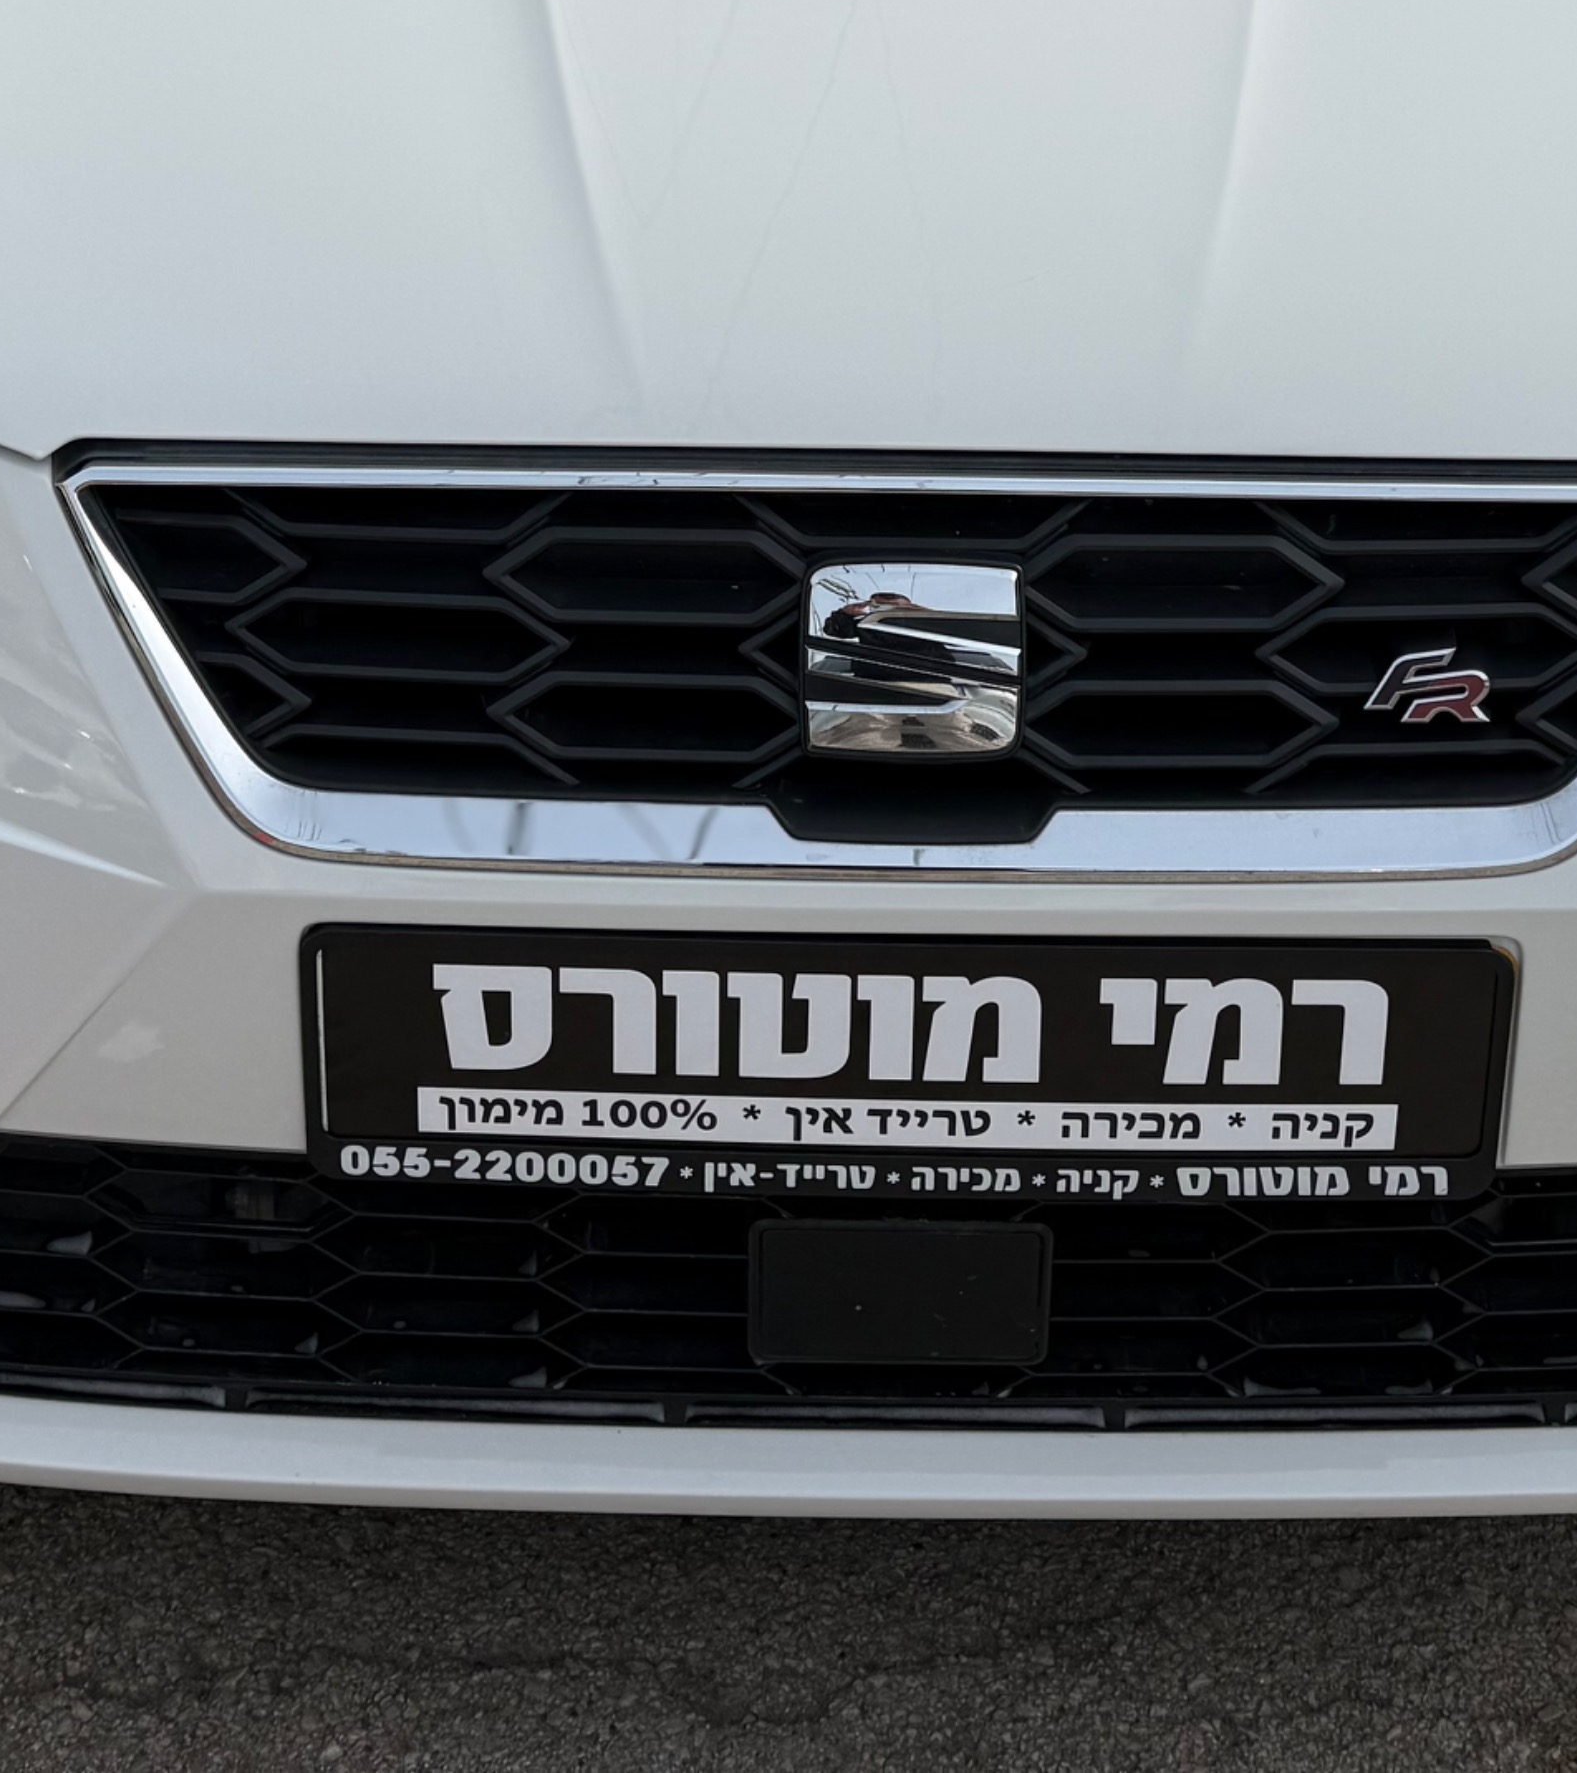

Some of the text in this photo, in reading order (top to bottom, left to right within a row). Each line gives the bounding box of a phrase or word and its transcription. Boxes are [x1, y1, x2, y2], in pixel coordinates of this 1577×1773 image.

[1363, 647, 1491, 722] FR
[433, 963, 1389, 1085] רמי מוטורס
[438, 1095, 1374, 1148] קניה מכירה טרייד אין 100% מימון
[340, 1144, 1449, 1200] רמי מוטורס קניה מכירה טרייד-אין 055-2200057
